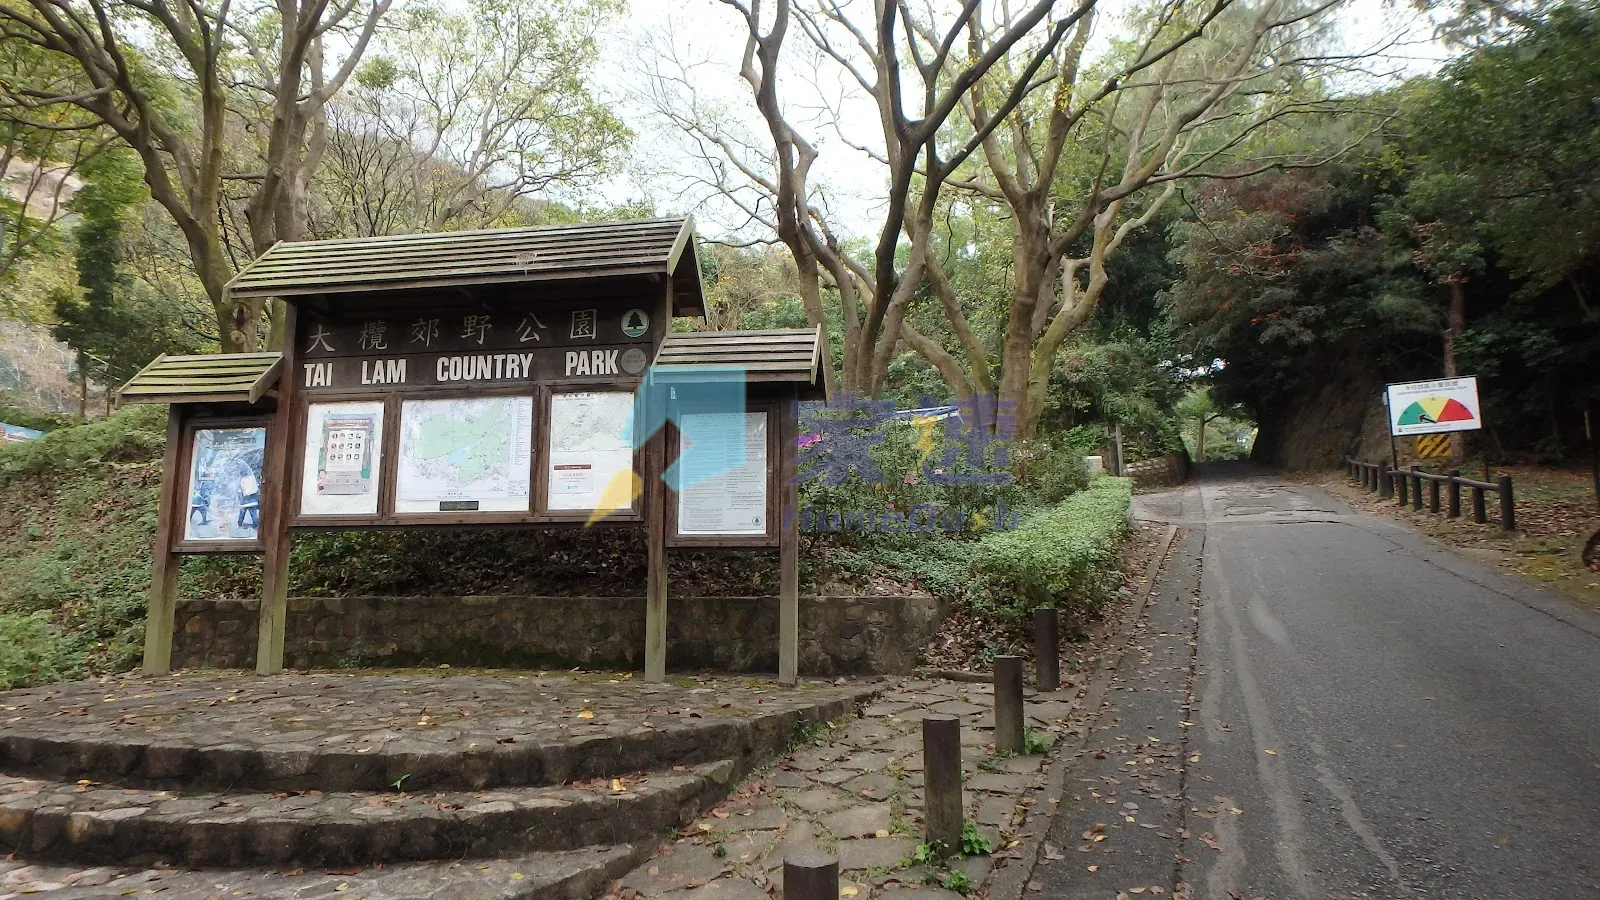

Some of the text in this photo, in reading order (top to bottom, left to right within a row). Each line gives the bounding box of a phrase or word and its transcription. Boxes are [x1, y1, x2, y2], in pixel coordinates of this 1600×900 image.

[304, 308, 598, 354] 大欖郊野公園
[304, 362, 333, 387] TAI
[361, 359, 407, 385] LAM
[436, 353, 534, 381] COUNTRY
[565, 349, 619, 376] PARK
